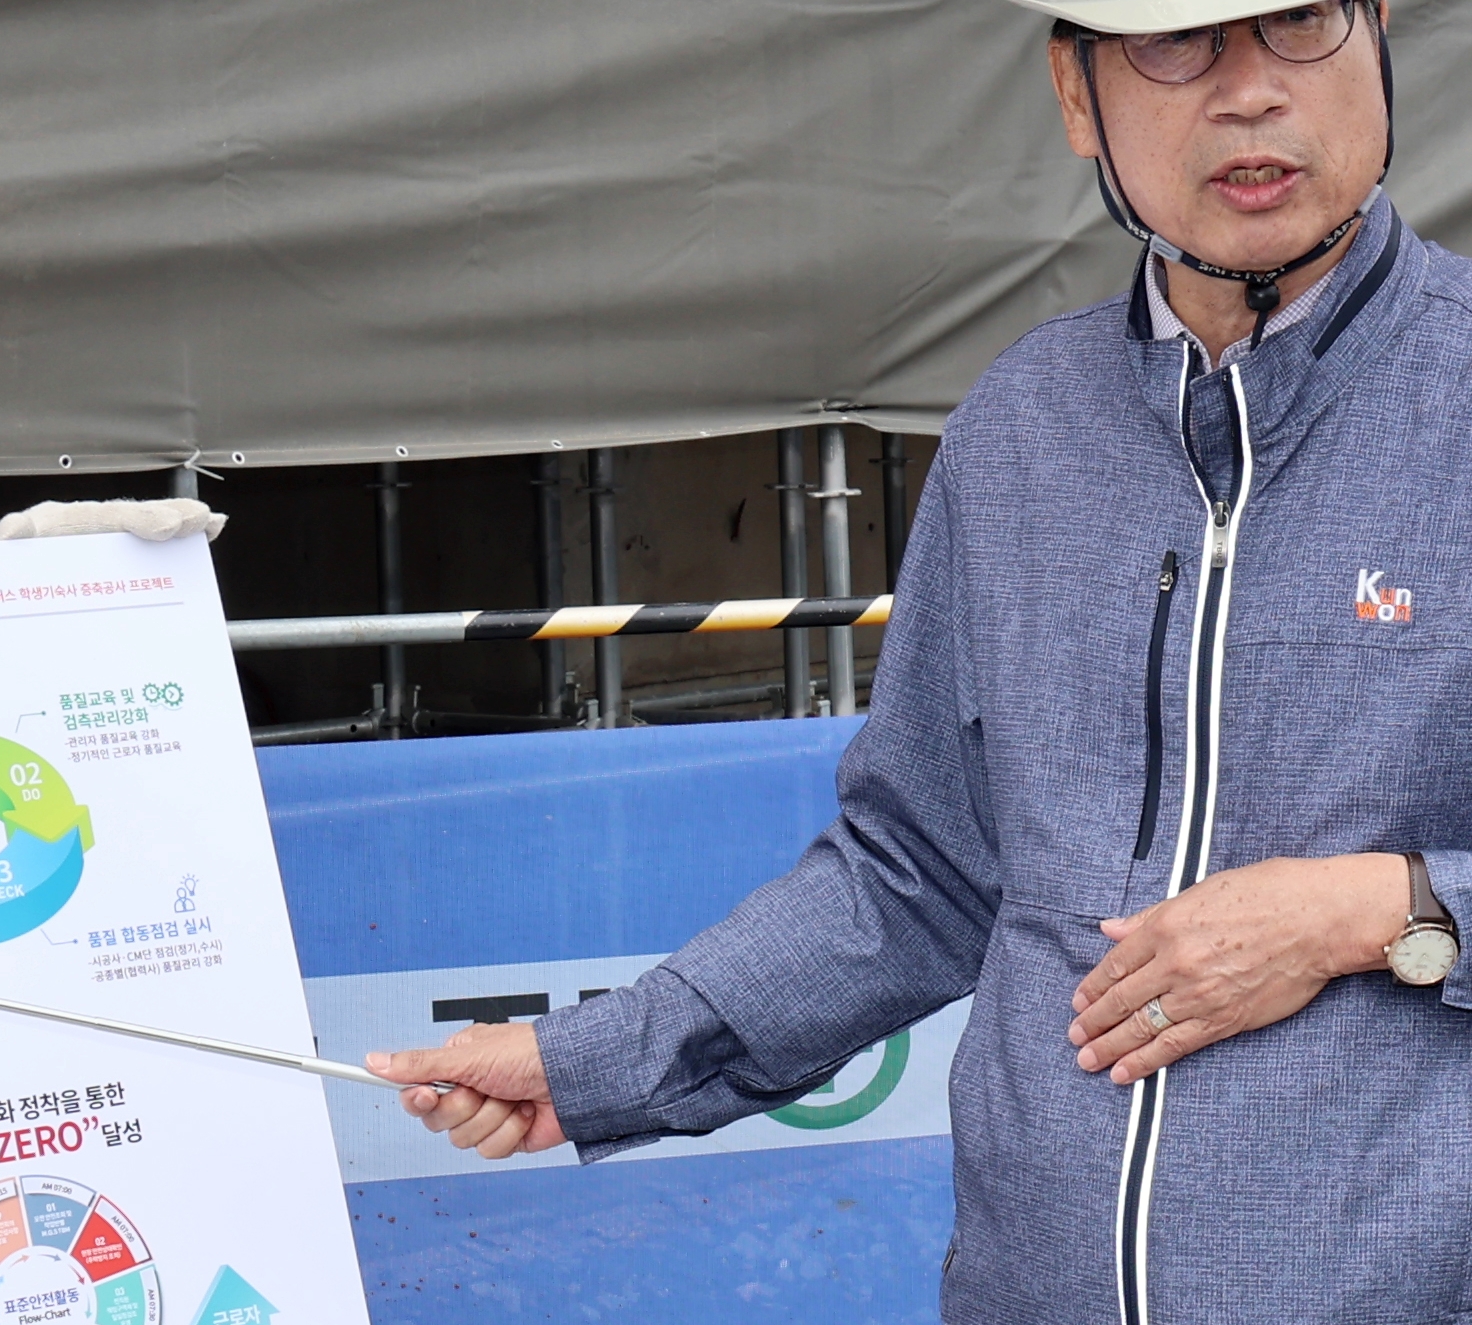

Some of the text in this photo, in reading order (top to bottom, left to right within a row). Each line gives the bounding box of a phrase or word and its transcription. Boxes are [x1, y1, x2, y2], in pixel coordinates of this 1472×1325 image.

[59, 687, 136, 711] 품질교육 및
[63, 707, 149, 731] 검측관리강화
[9, 762, 43, 787] 02
[21, 787, 41, 802] DO
[88, 916, 212, 949] 품질 합동점검 실시
[19, 1089, 81, 1121] 정착을
[85, 1082, 125, 1110] 통한
[101, 1118, 142, 1147] 달성
[4, 1287, 79, 1314] 표준안전활동
[18, 1307, 71, 1325] Flow-Chart
